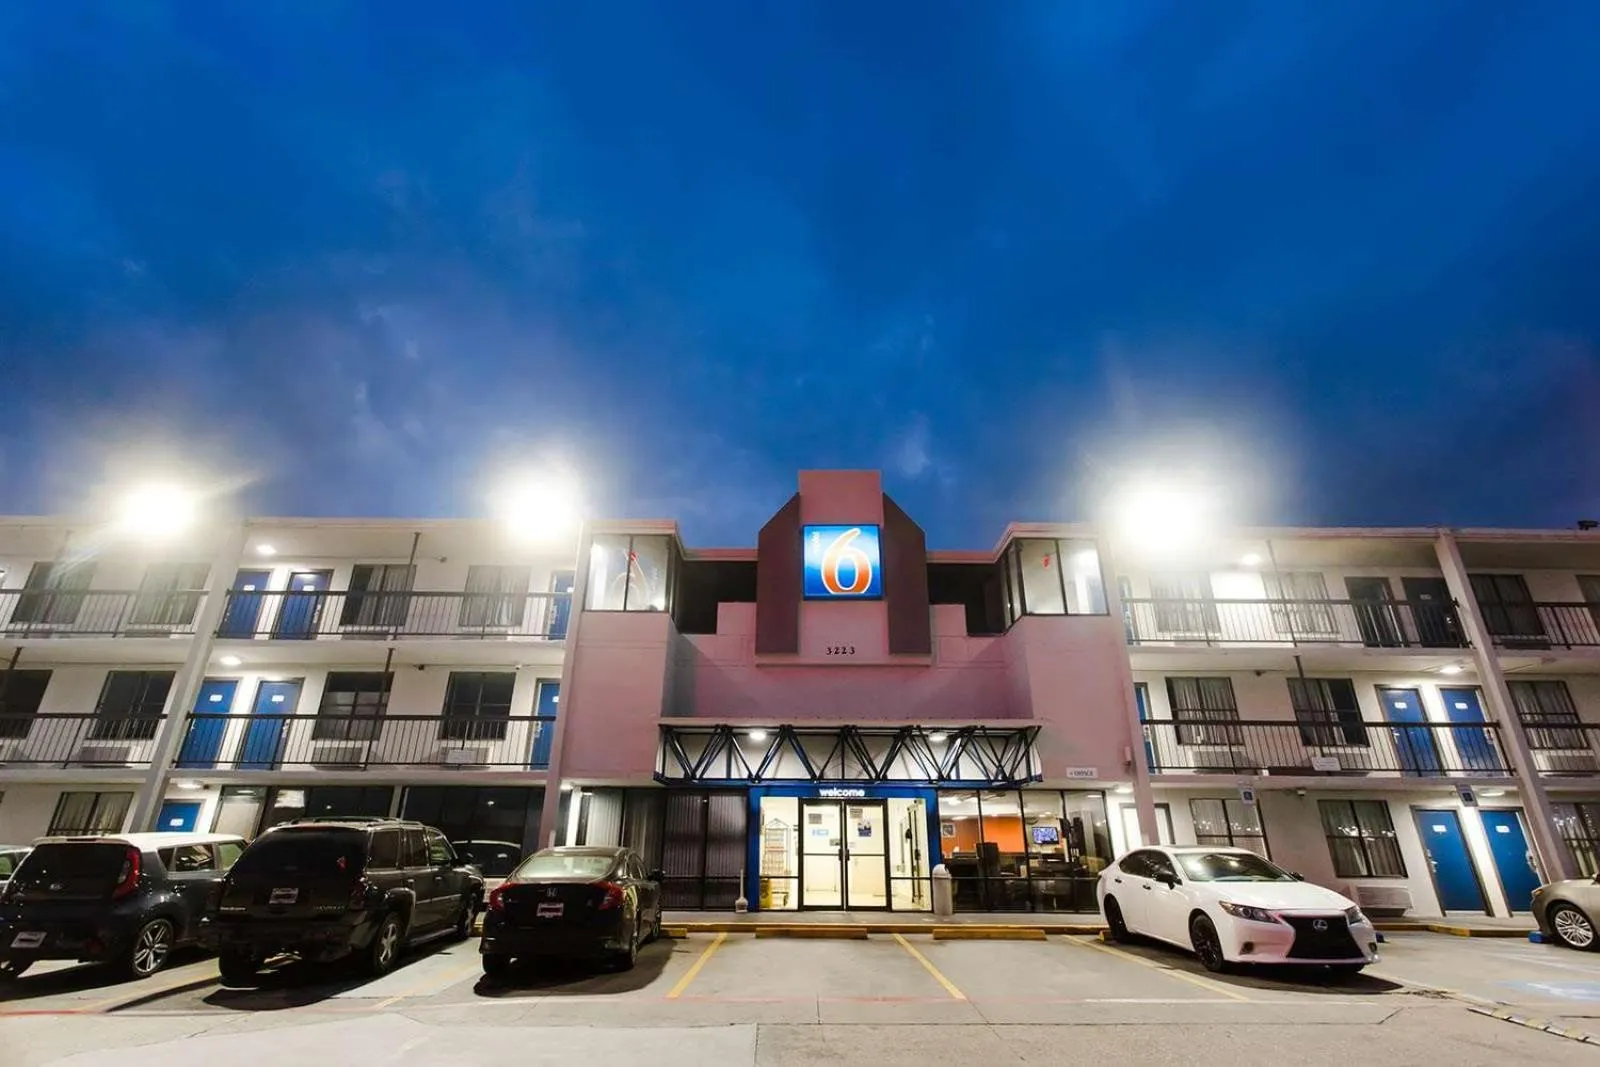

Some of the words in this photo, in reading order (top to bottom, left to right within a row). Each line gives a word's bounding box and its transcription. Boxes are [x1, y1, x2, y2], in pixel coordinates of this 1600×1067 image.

[821, 527, 872, 595] 6
[825, 646, 855, 655] 3223
[819, 787, 865, 797] welcome
